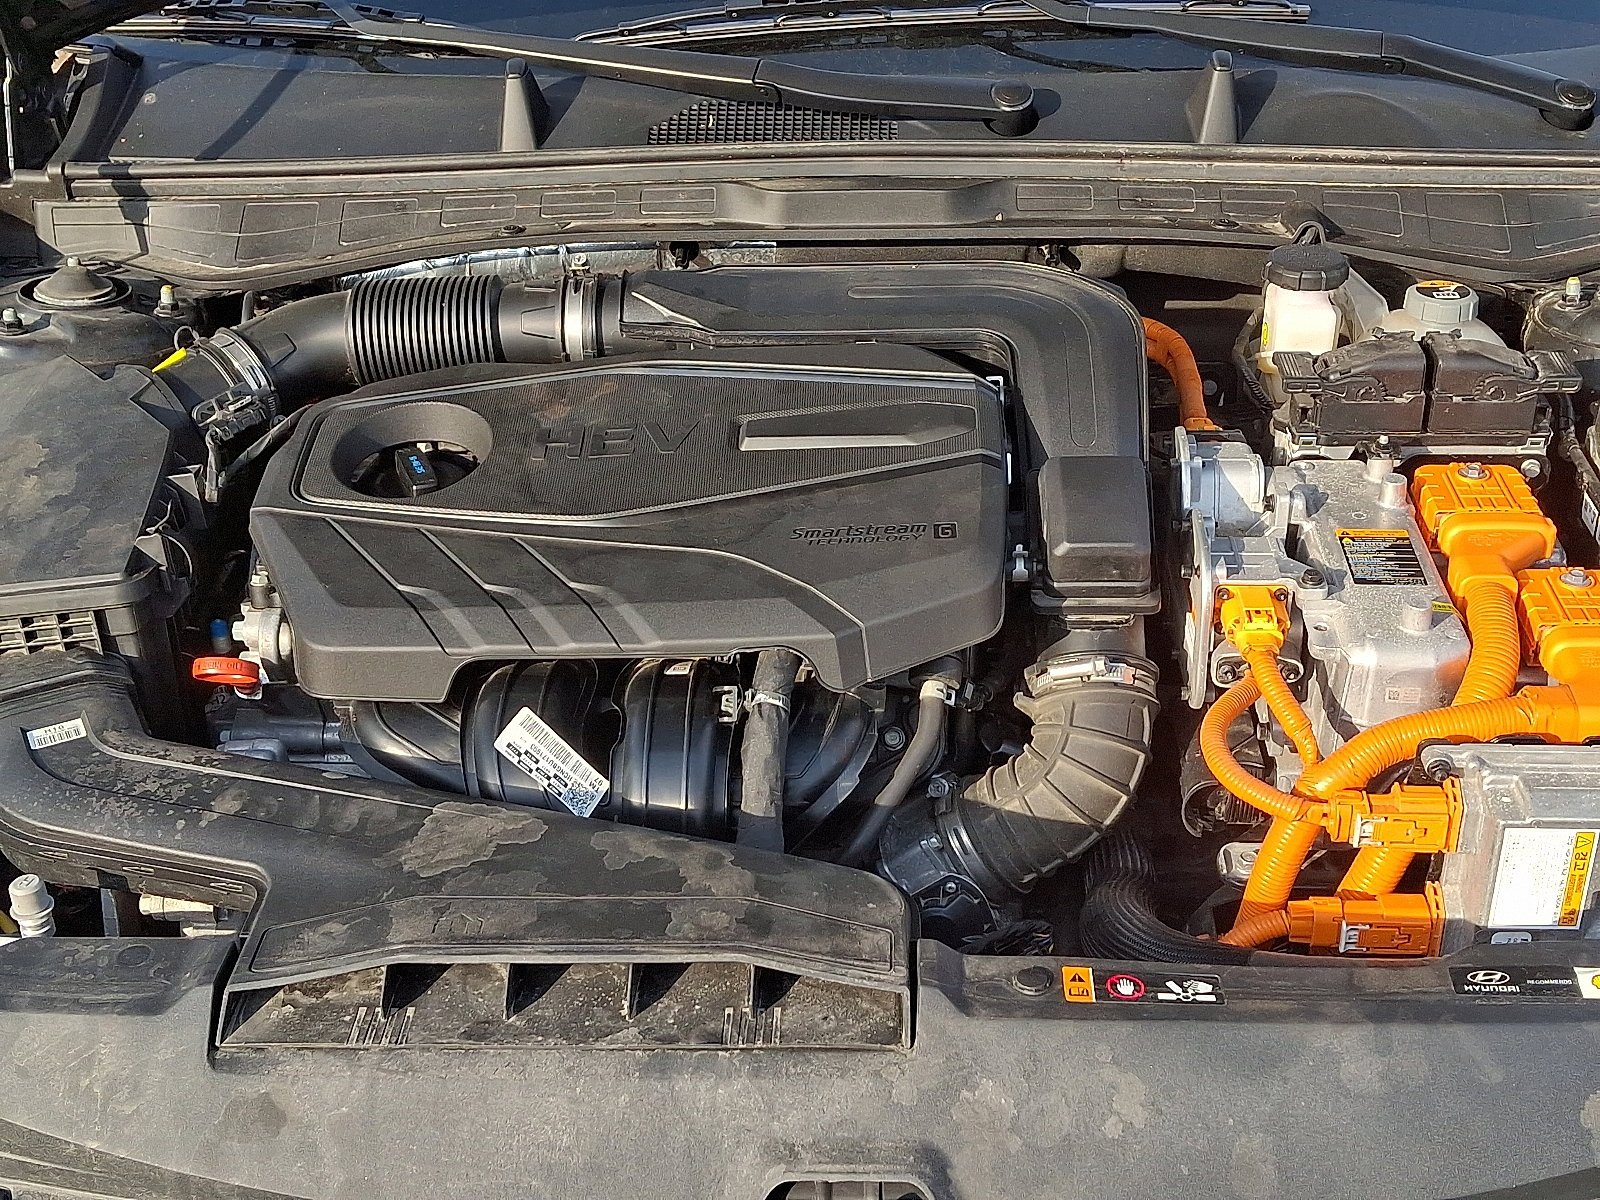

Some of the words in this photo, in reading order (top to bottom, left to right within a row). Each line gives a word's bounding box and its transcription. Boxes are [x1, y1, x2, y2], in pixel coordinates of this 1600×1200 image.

[531, 420, 700, 460] HEV
[790, 523, 928, 540] Smartstream
[805, 533, 923, 546] TECHNOLOGY
[1573, 852, 1588, 871] 경고
[1464, 984, 1520, 993] HYUNDAI
